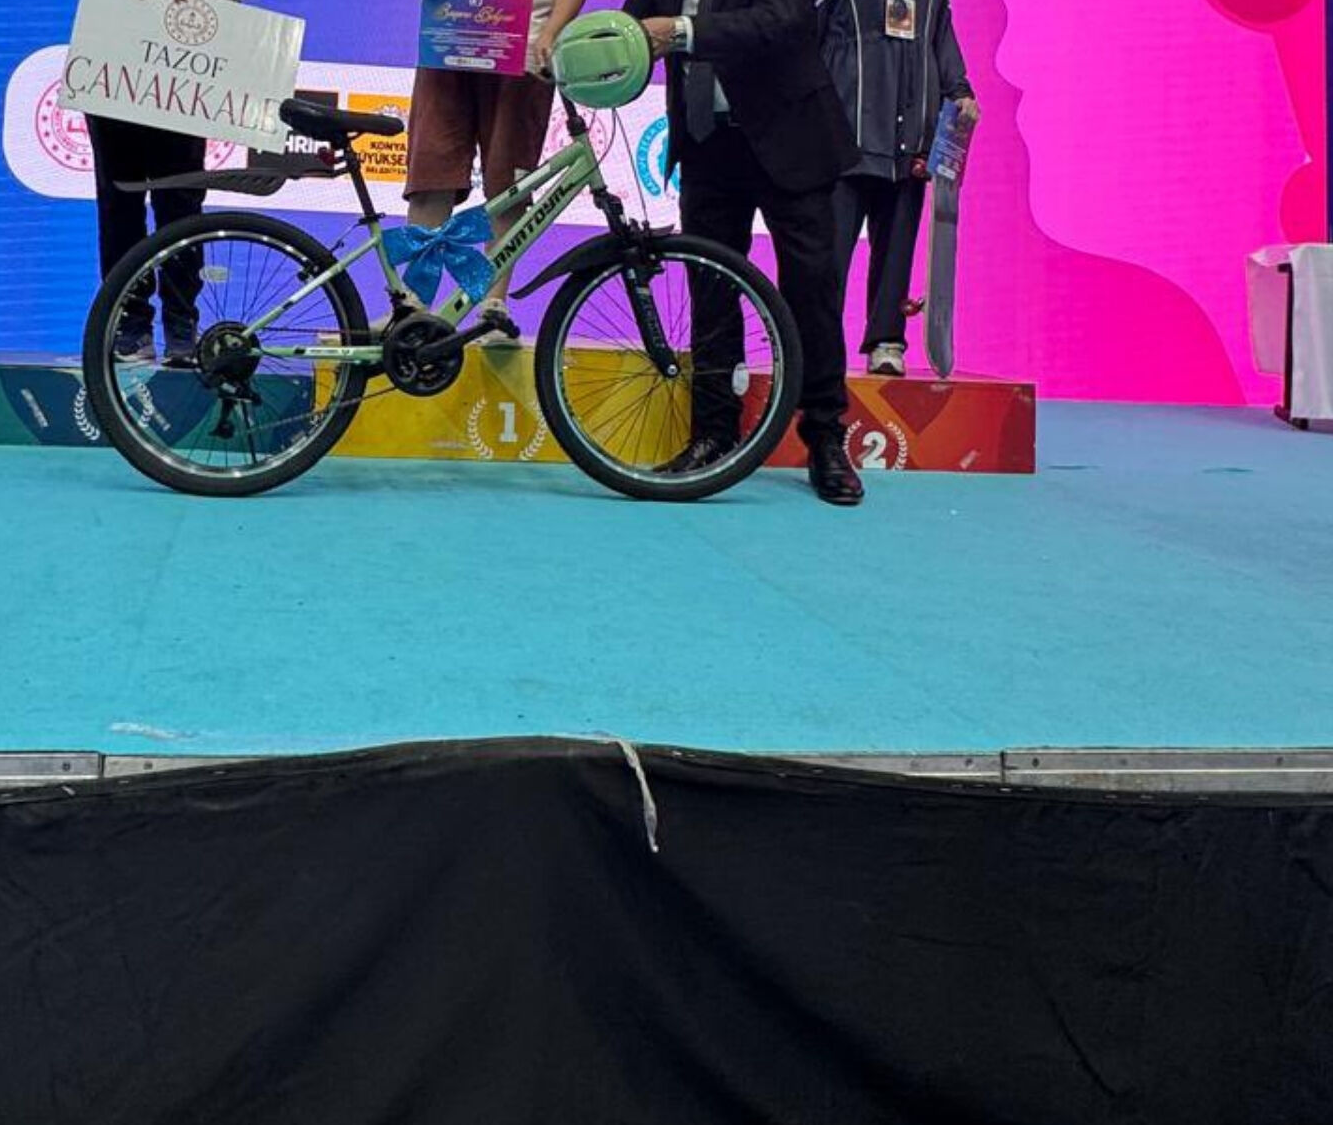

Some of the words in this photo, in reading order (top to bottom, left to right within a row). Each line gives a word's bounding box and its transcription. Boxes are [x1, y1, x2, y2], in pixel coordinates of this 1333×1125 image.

[139, 40, 229, 79] TAZOF
[65, 55, 280, 135] ÇANAKKALE
[497, 401, 518, 444] 1
[861, 430, 887, 470] 2
